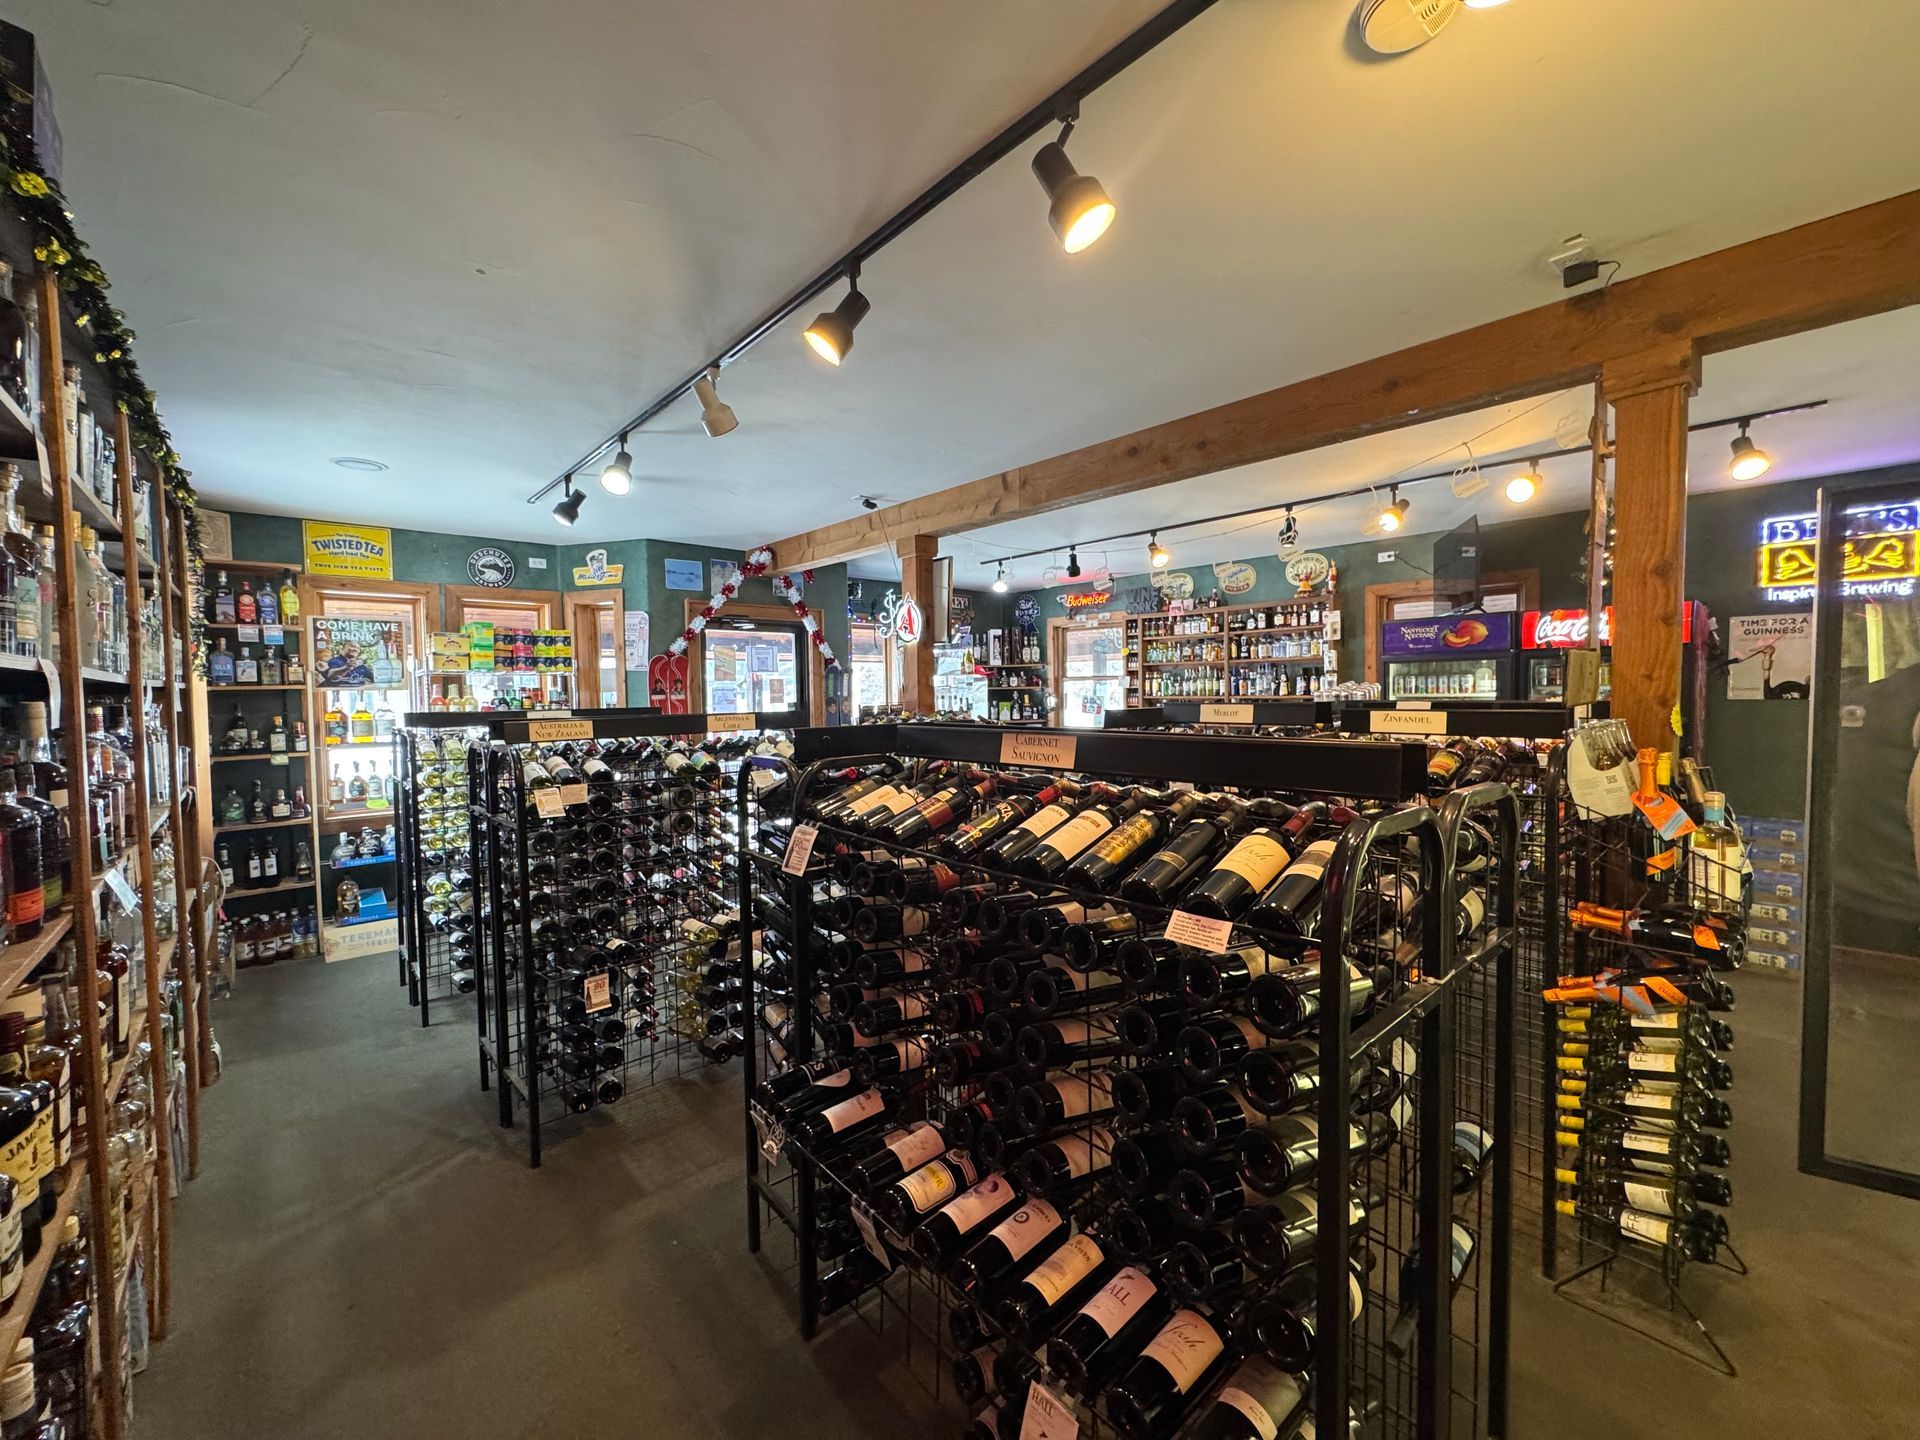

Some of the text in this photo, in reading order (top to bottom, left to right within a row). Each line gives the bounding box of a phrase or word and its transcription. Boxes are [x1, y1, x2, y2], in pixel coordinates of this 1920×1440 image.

[311, 538, 384, 557] TWISTED TEA
[327, 549, 345, 557] Hard
[359, 551, 370, 560] Tea
[470, 549, 512, 569] DESCHUTES
[1067, 593, 1109, 607] Budweiser
[316, 619, 400, 632] COME HAVE
[1739, 616, 1809, 628] TIME FOR A
[1400, 624, 1440, 635] NANTUCKET
[1743, 625, 1805, 637] GUINNESS
[316, 630, 379, 641] A DRINK
[1403, 632, 1437, 641] NECTARS
[1213, 708, 1239, 717] MERLOT
[713, 715, 745, 723] ARGENTINA
[1382, 713, 1433, 725] ZINFANDEL
[538, 722, 578, 730] AUSTRALIA
[722, 721, 742, 730] CHILE
[535, 730, 589, 739] NEW ZEALAND
[1015, 733, 1059, 748] CABERNET
[1011, 745, 1060, 763] SAUVIGNON
